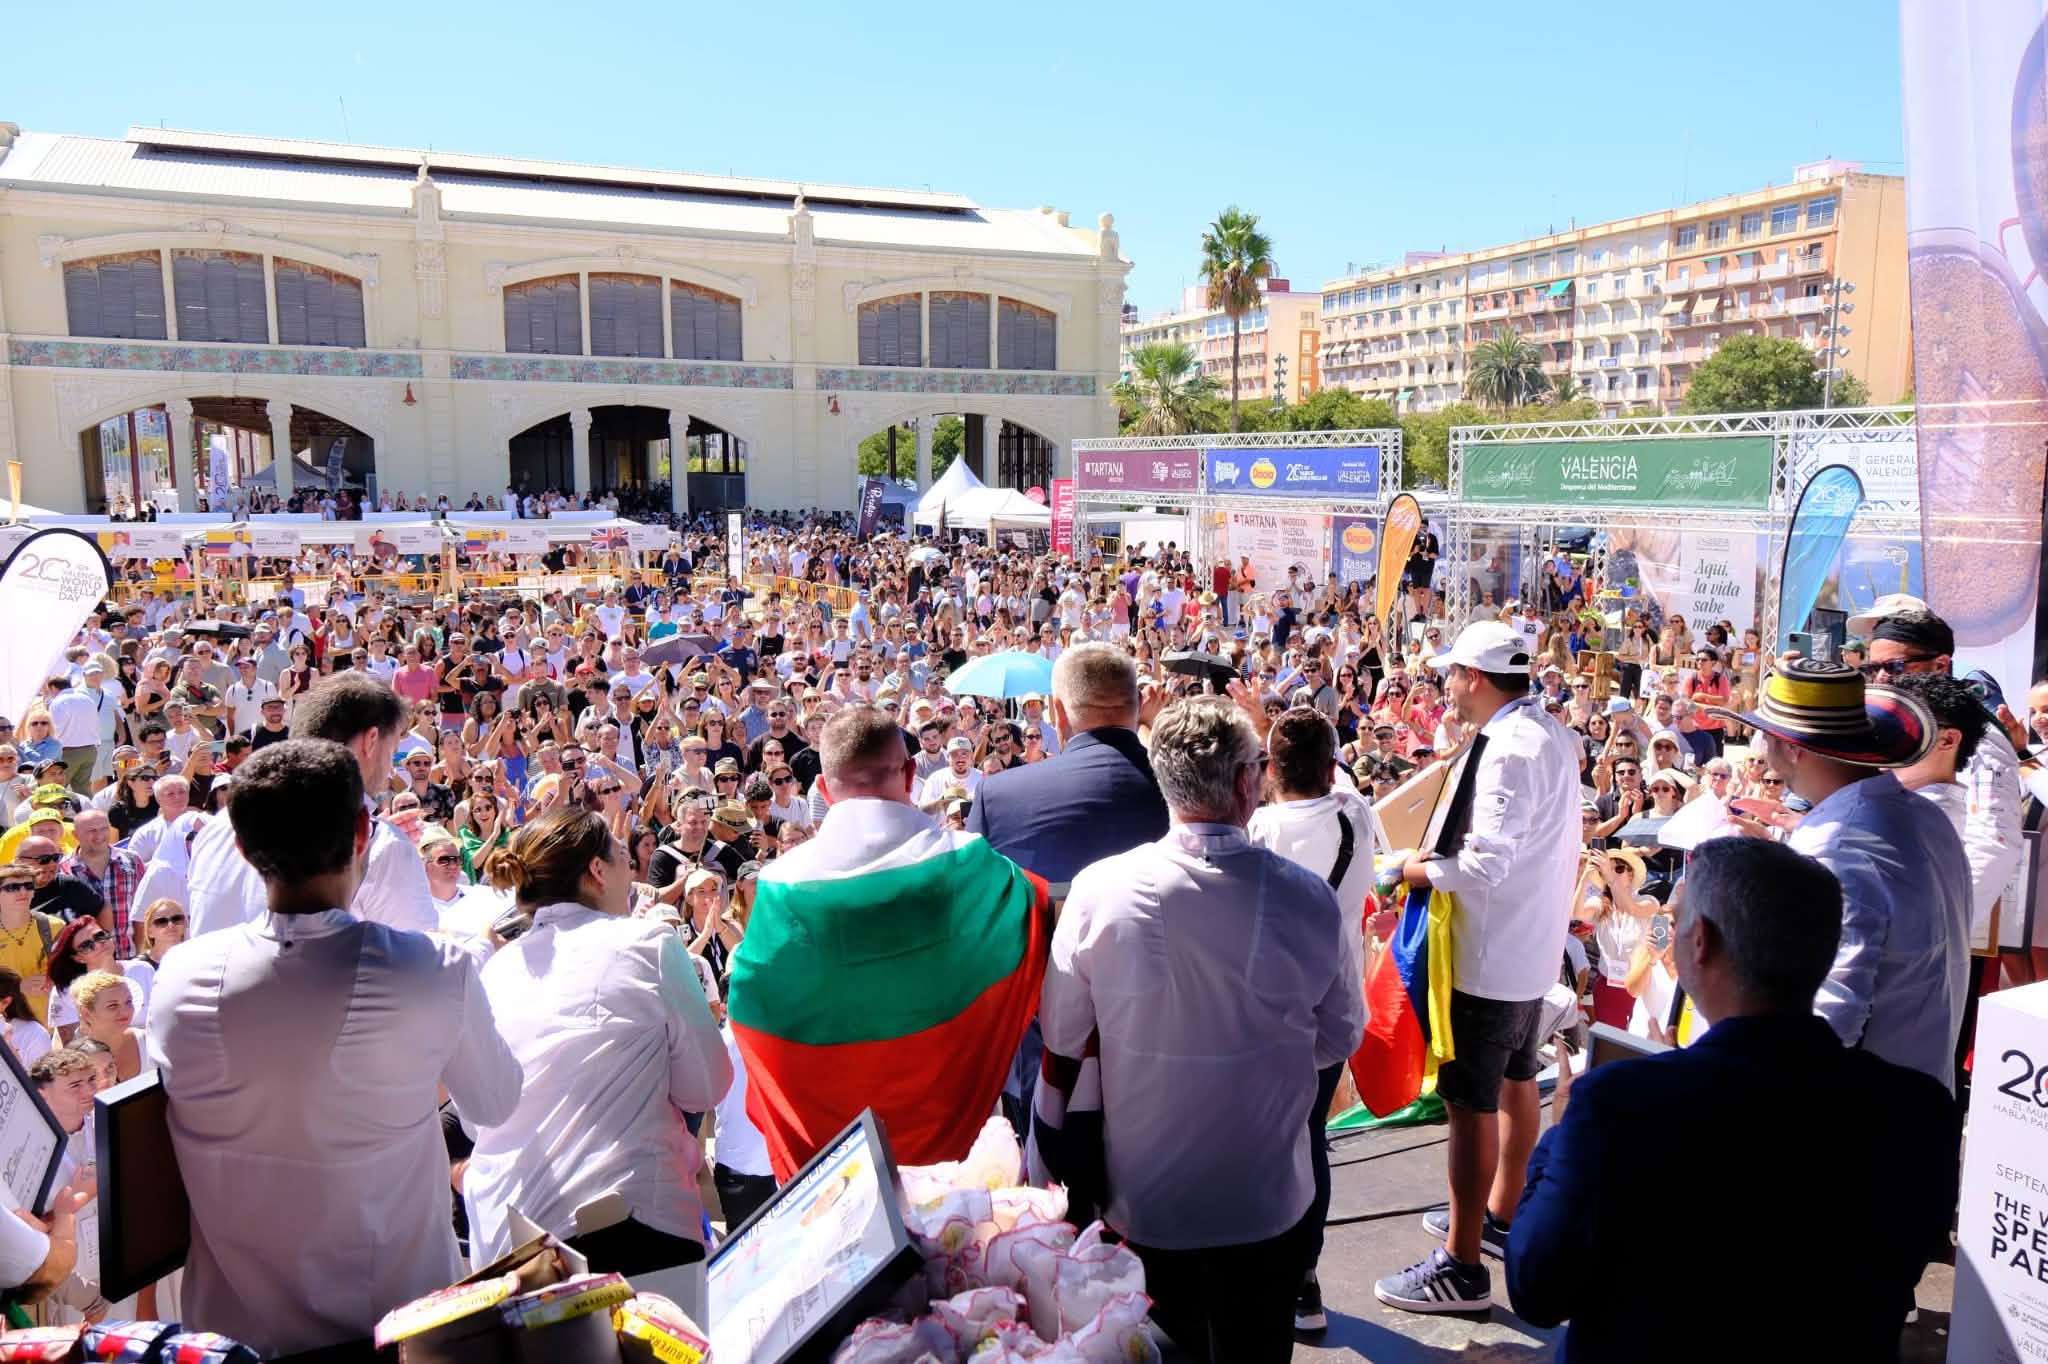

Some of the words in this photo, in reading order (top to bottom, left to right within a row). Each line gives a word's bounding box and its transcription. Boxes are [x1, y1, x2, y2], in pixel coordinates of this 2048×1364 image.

[1091, 462, 1124, 477] TARTANA
[1561, 456, 1638, 479] VALENCIA
[1240, 515, 1277, 528] TARTANA
[1694, 578, 1708, 594] la
[1711, 580, 1741, 597] vida
[1693, 598, 1725, 614] sabe
[1994, 1192, 2031, 1221] THE
[1992, 1212, 2048, 1255] SPE
